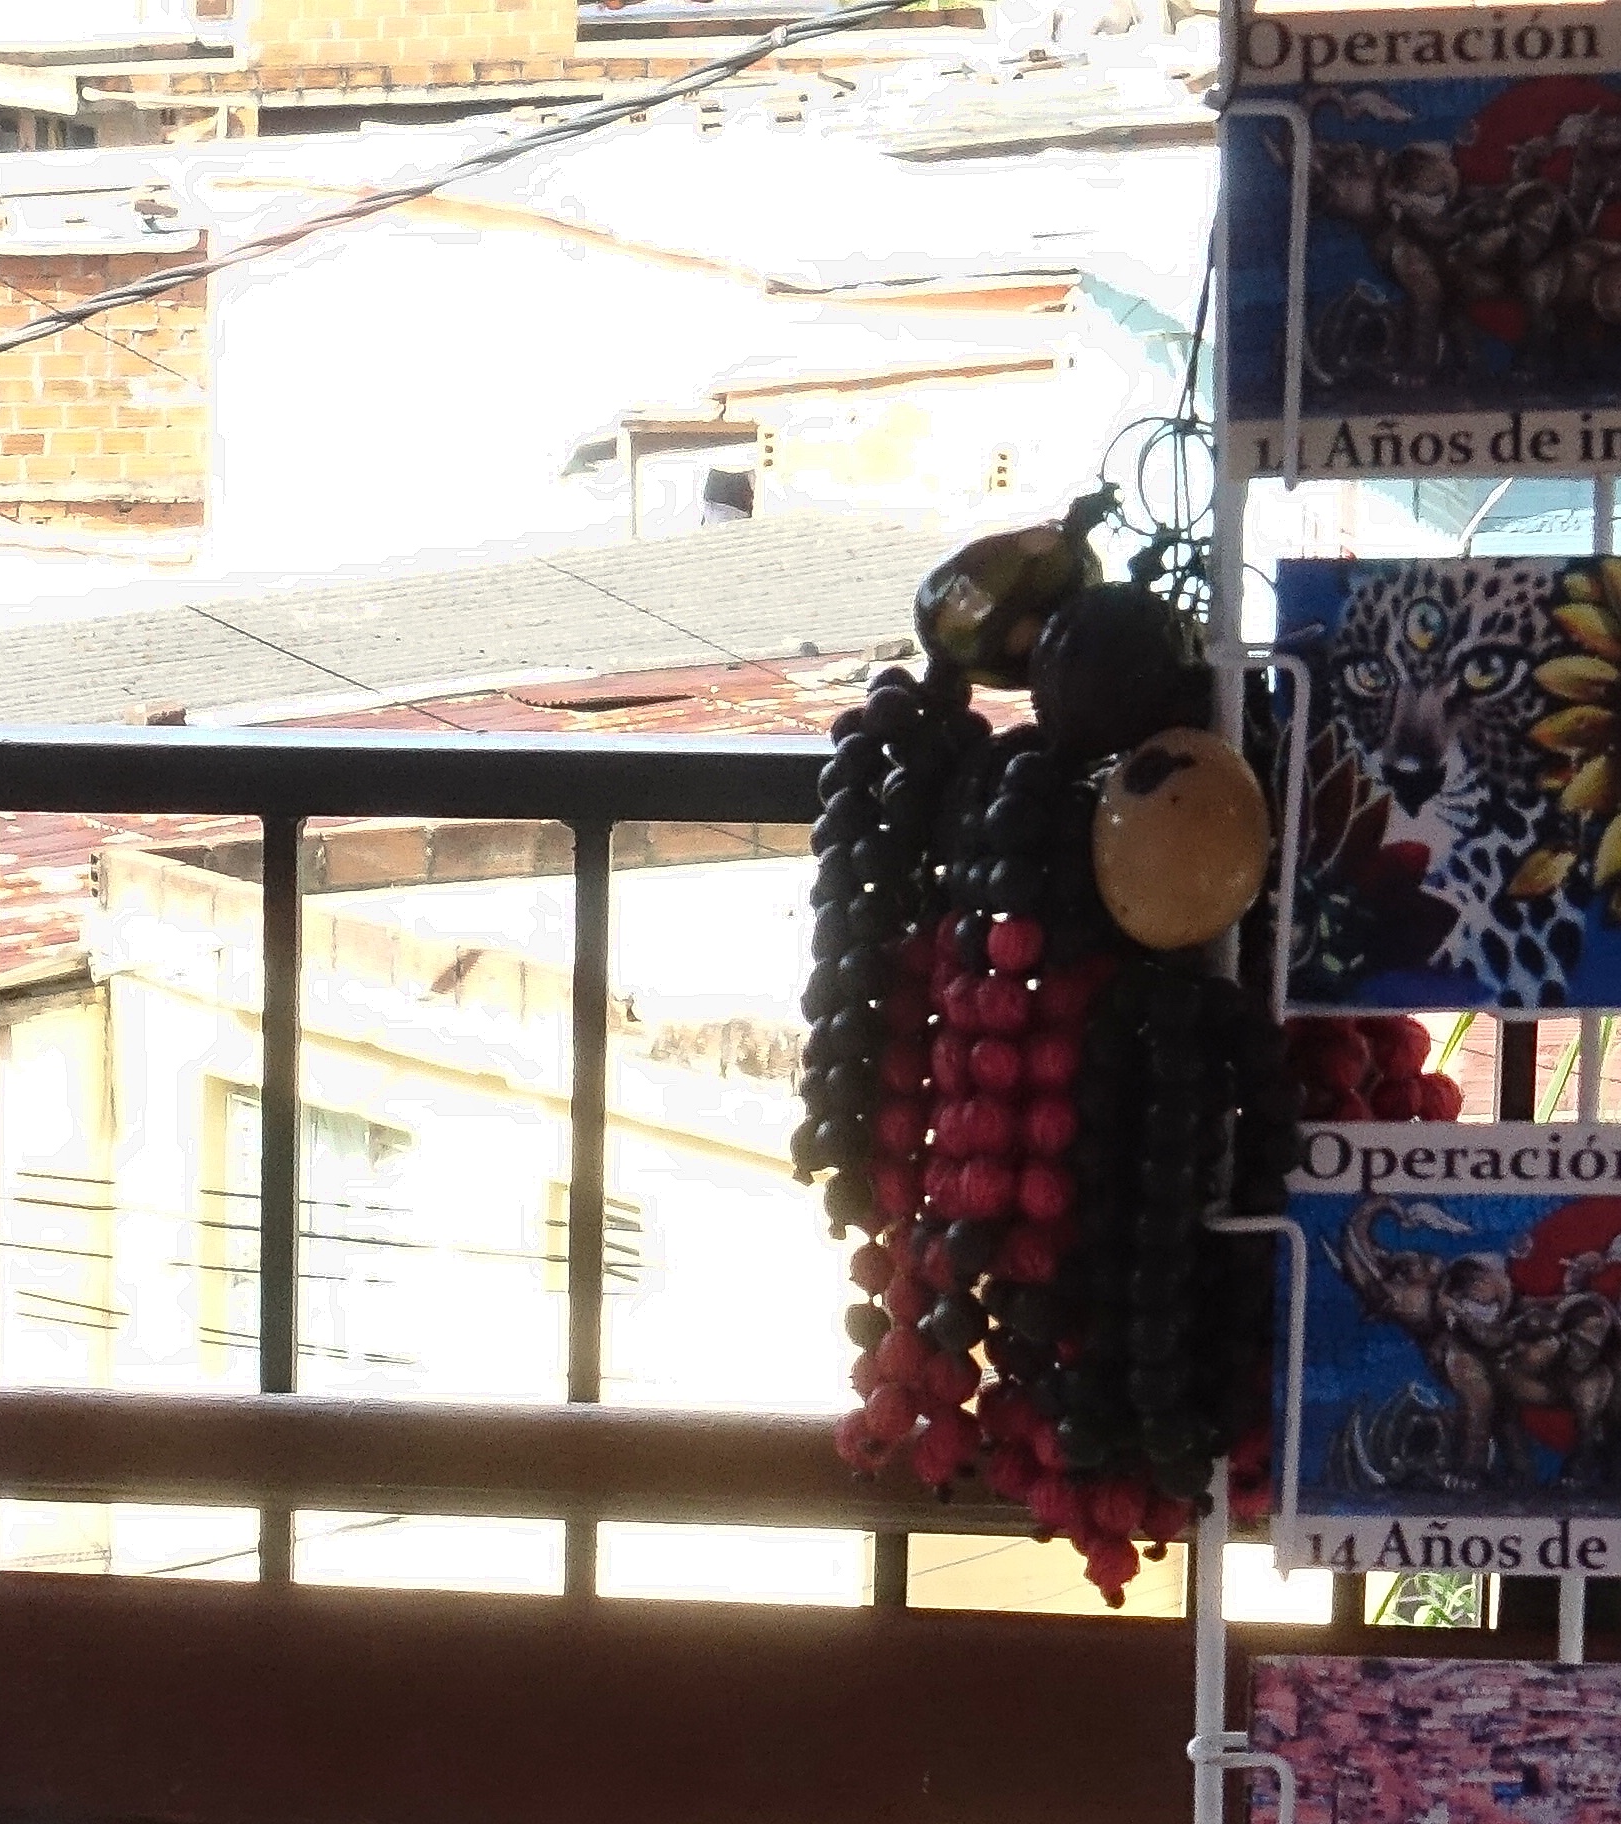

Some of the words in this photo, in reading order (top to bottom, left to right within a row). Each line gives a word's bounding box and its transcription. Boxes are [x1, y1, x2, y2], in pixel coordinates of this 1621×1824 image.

[1241, 11, 1599, 84] Operación
[1323, 420, 1474, 469] Años
[1489, 413, 1561, 464] de
[1302, 1131, 1621, 1190] Operació
[1308, 1532, 1357, 1568] 14
[1376, 1520, 1522, 1570] Años
[1536, 1522, 1607, 1570] de
